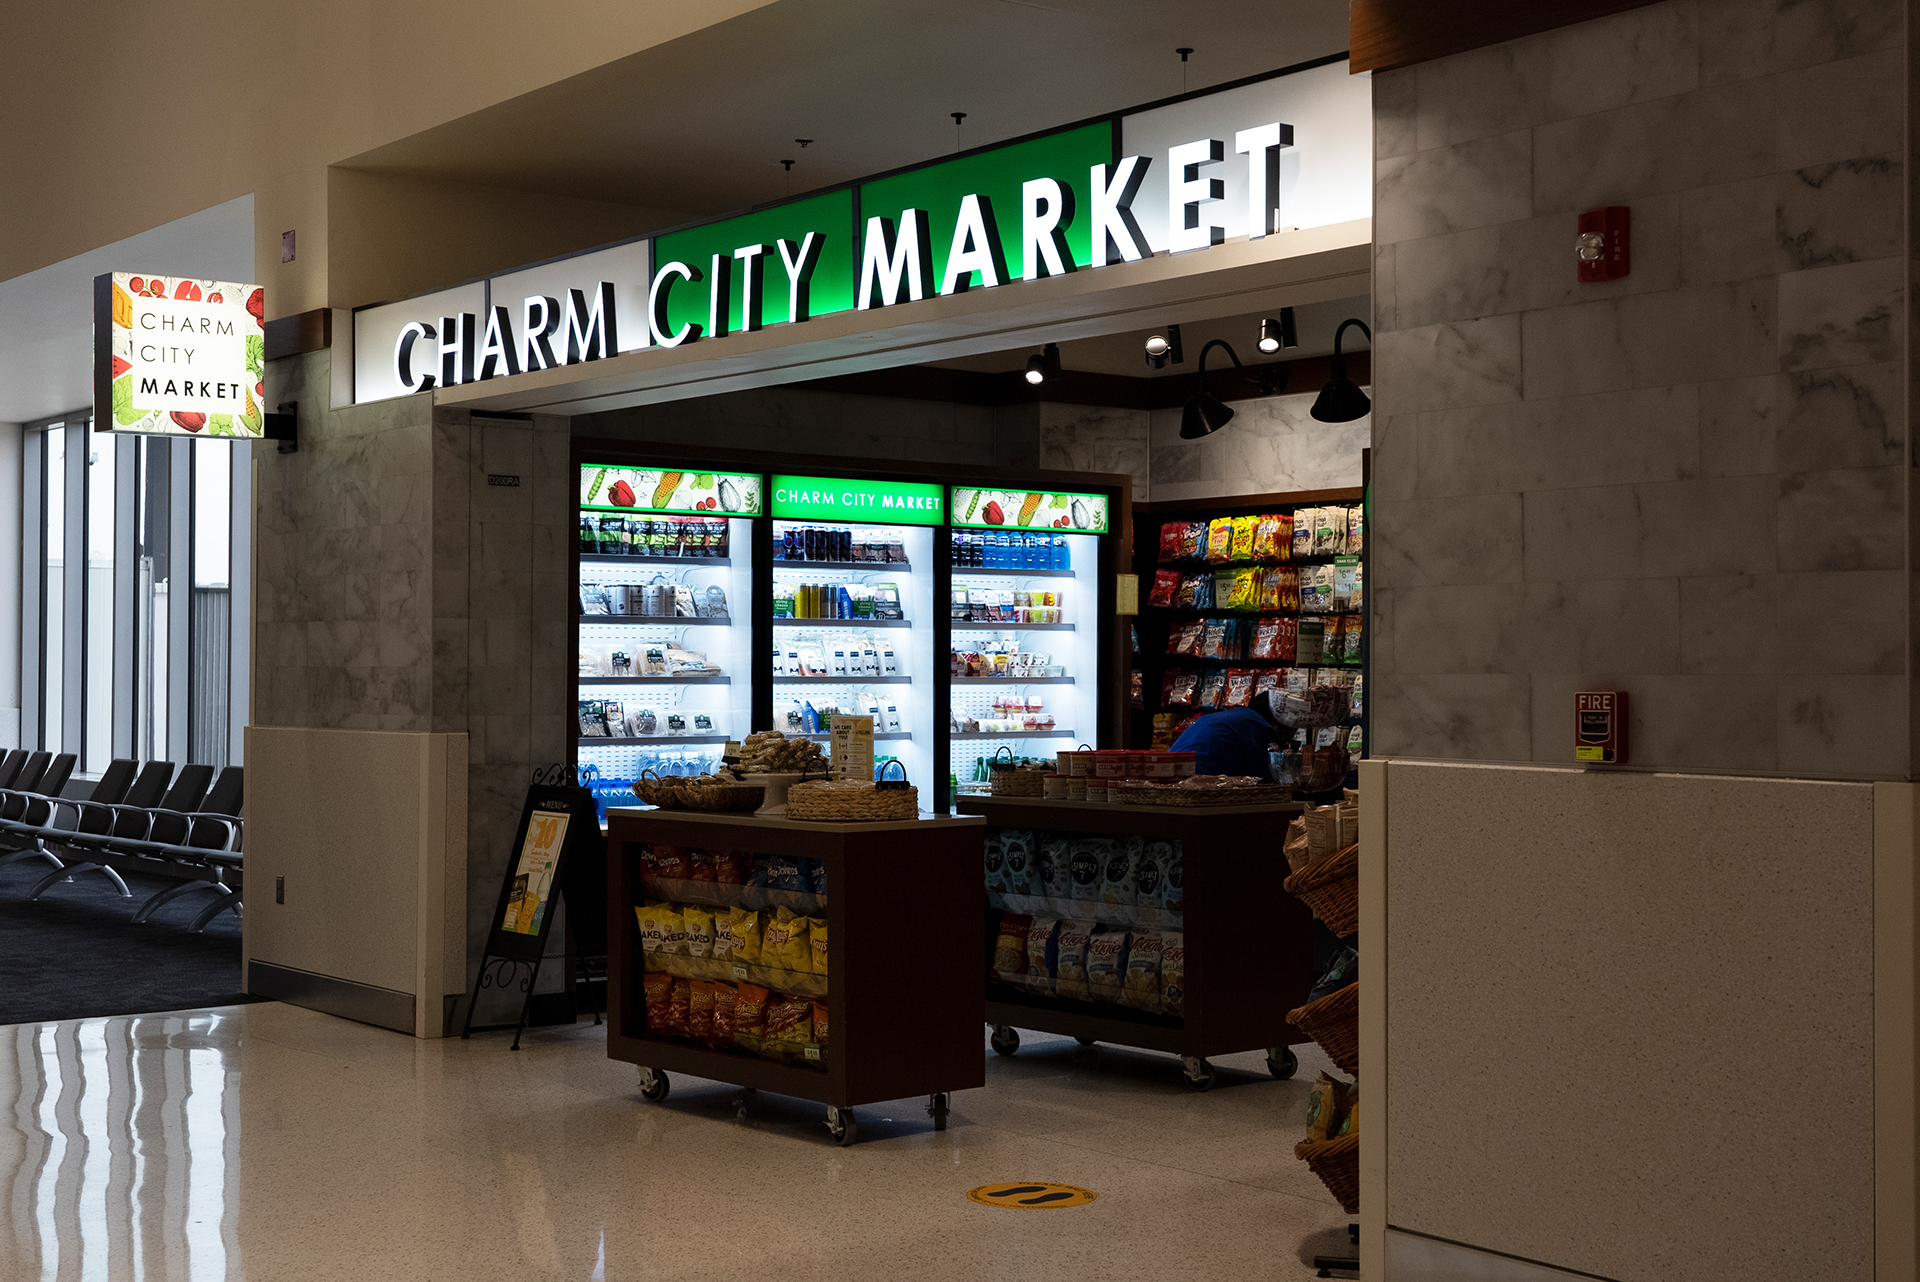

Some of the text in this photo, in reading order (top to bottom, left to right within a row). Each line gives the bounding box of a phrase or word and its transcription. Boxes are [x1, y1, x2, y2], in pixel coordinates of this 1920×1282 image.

[393, 121, 1292, 394] CHARM CITY MARKET
[140, 312, 234, 336] CHARM
[140, 345, 195, 364] CITY
[140, 377, 239, 399] MARKET
[776, 489, 940, 510] CHARM CITY MARKET
[1579, 695, 1611, 710] FIRE
[545, 800, 564, 810] MENU
[1071, 861, 1098, 873] SIMPLY
[1079, 870, 1086, 880] 7
